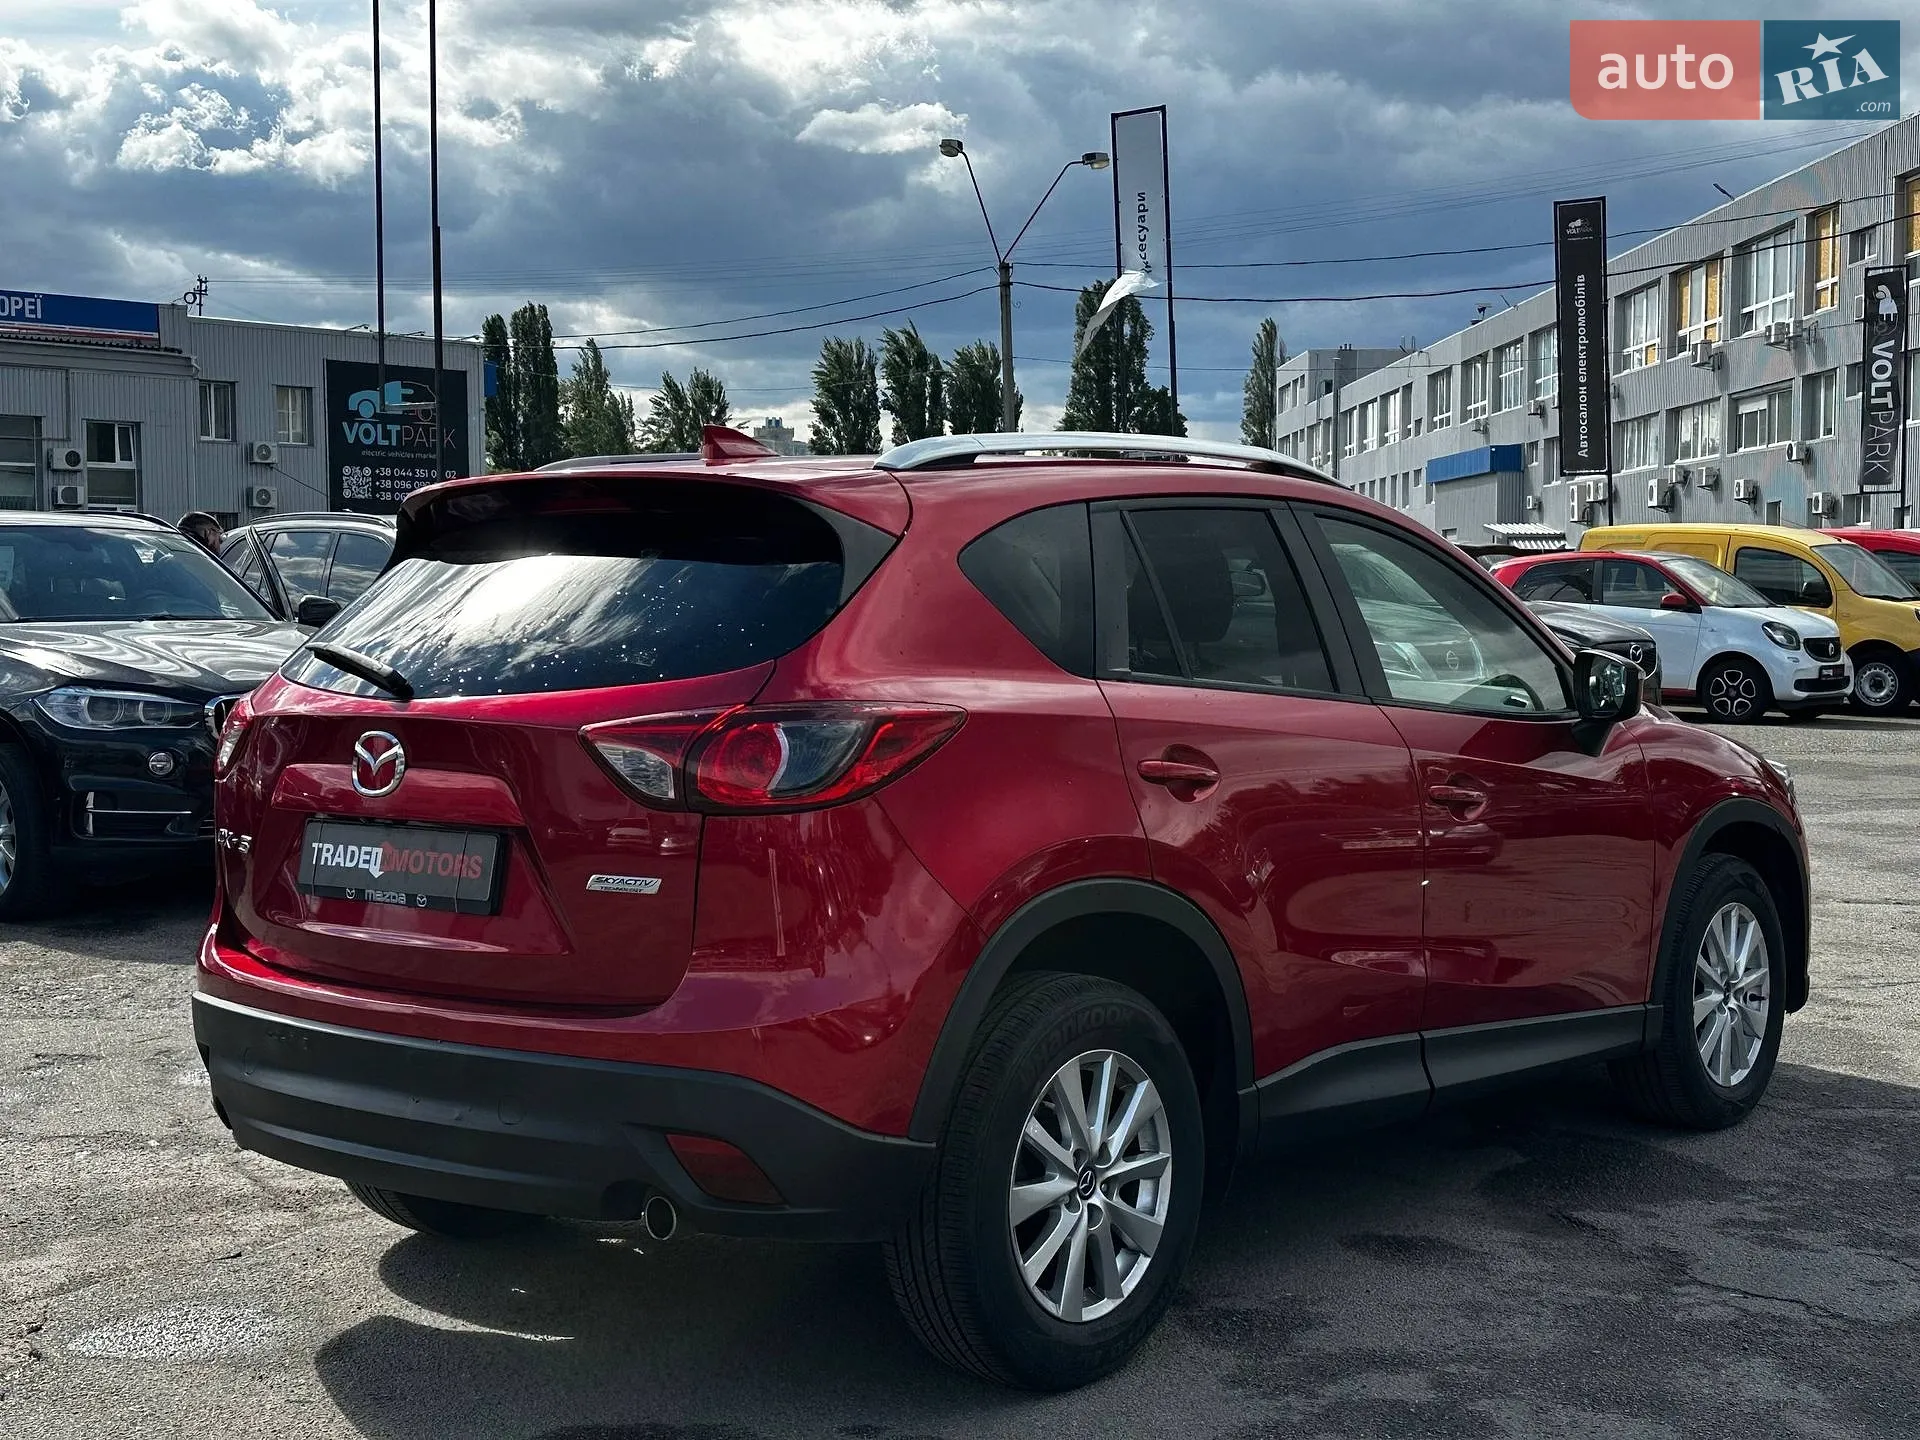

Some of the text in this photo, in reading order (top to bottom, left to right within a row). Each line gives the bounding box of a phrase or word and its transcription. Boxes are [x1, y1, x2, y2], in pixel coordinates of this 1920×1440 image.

[1574, 274, 1589, 458] Автосалон електромобілів
[1864, 339, 1896, 476] VOLTPARK
[387, 451, 415, 459] vehicles
[375, 467, 391, 477] +38
[394, 467, 412, 477] 044
[414, 468, 429, 477] 351
[445, 470, 457, 479] 02
[375, 479, 391, 489] +38
[394, 479, 412, 489] 096
[375, 491, 391, 501] +38
[593, 876, 659, 889] SKYACTIV
